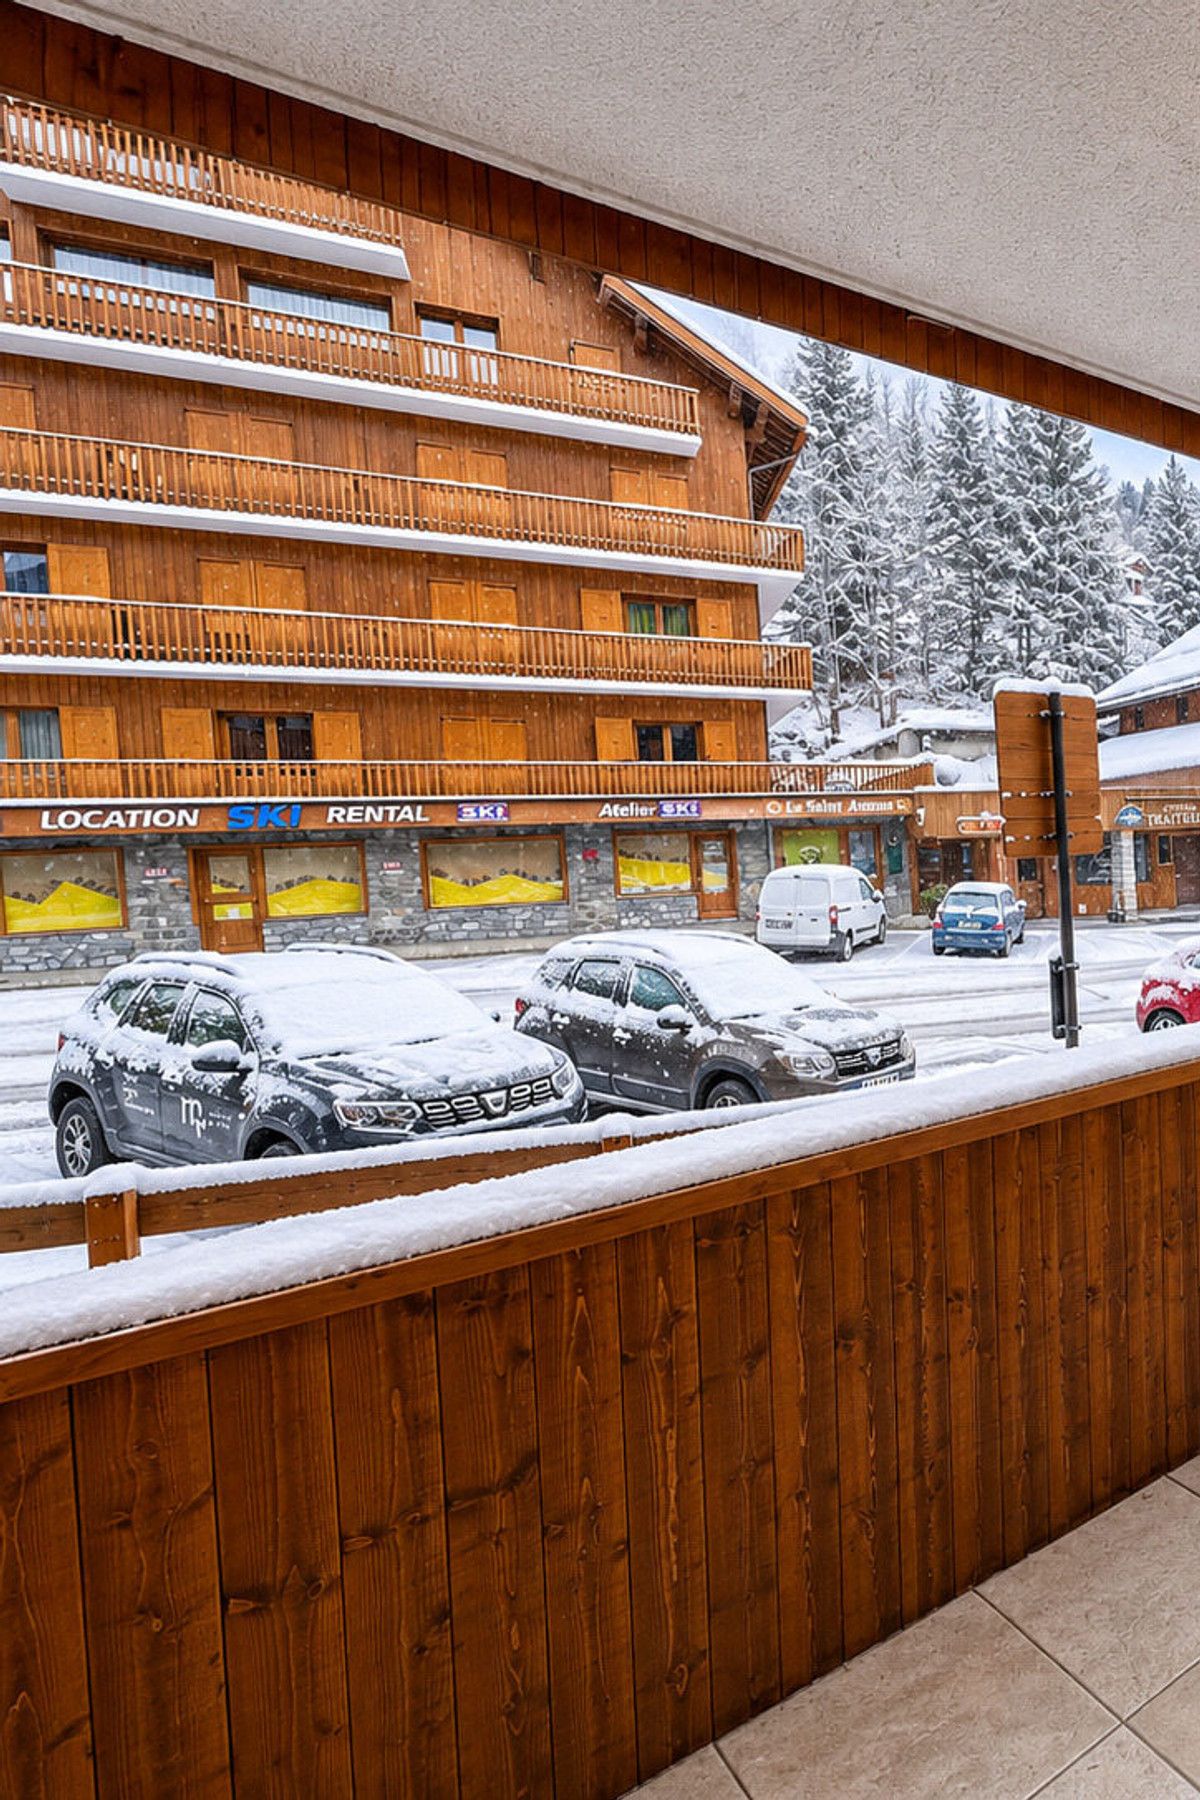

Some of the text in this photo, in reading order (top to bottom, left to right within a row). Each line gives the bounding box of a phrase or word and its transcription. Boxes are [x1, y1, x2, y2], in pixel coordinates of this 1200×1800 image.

[40, 803, 430, 830] LOCATION SKI RENTAL
[598, 801, 657, 818] Atelier
